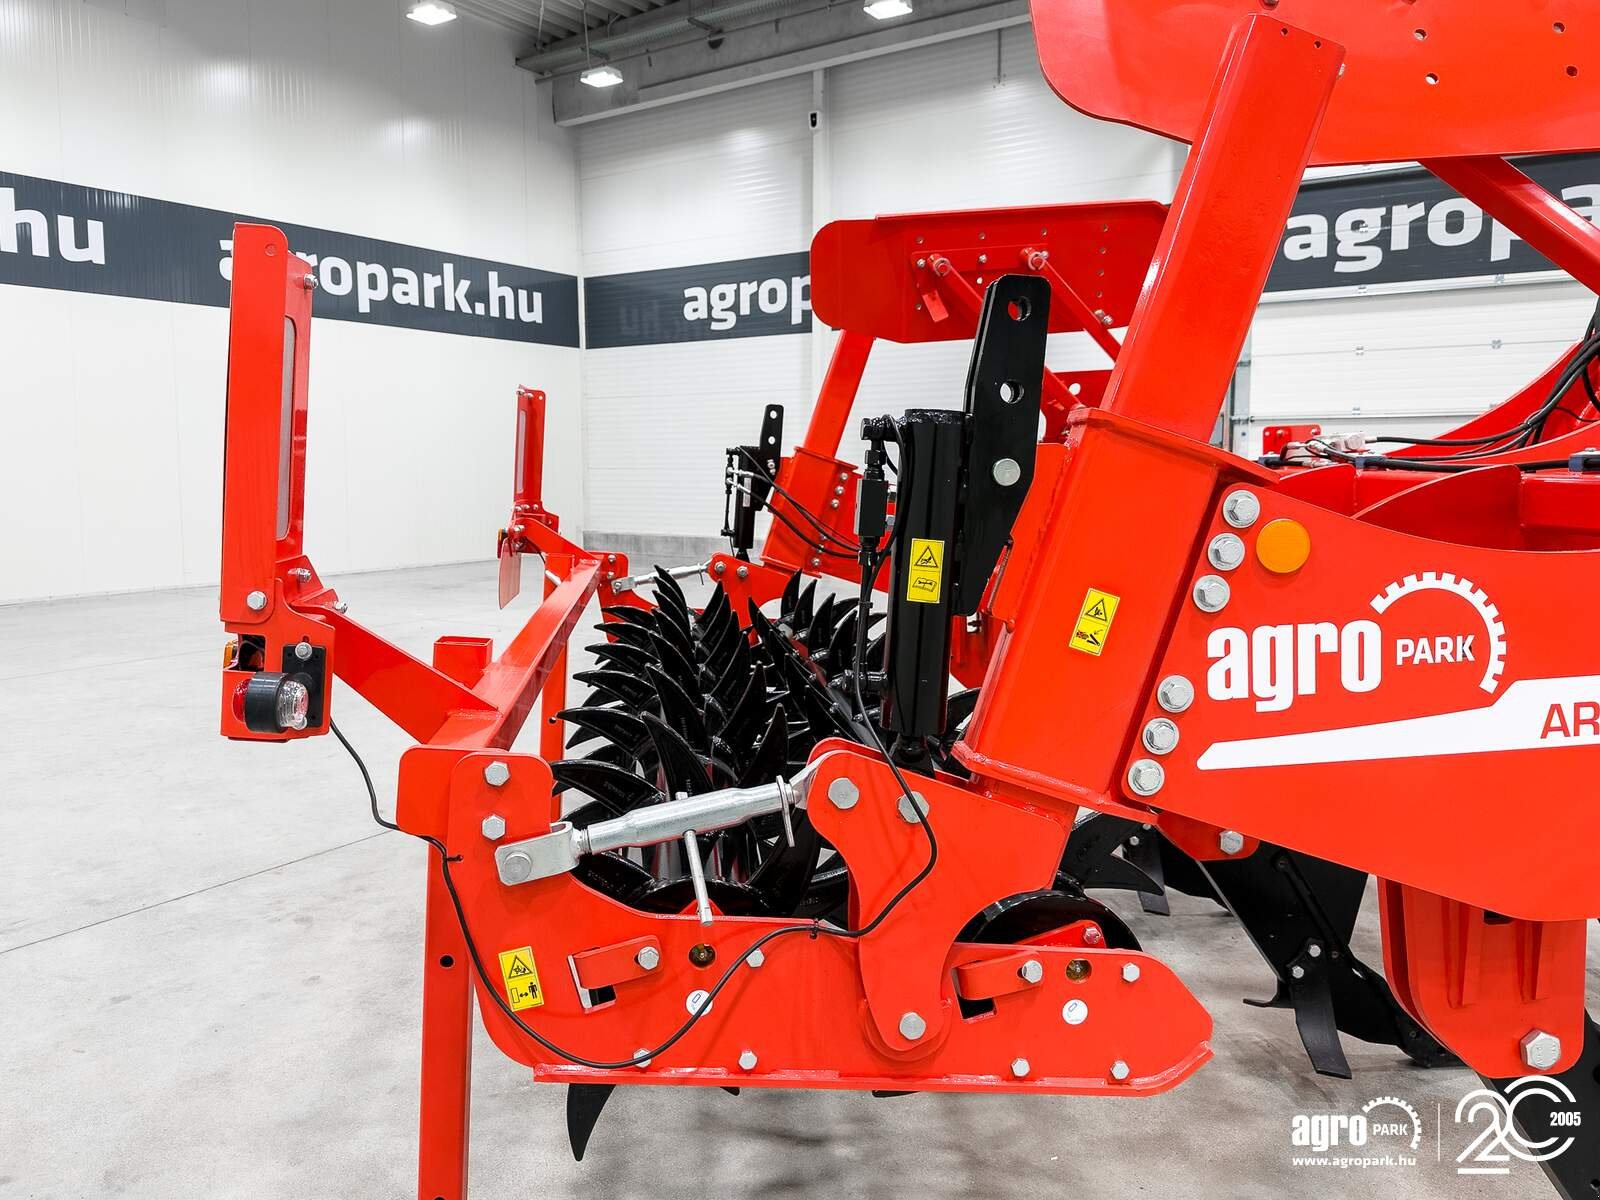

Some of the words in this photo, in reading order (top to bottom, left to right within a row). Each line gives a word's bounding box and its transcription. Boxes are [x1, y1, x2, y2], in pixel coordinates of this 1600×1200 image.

[219, 240, 543, 324] opark.hu
[1206, 619, 1382, 713] agro
[1396, 634, 1476, 666] PARK
[1540, 701, 1600, 739] AR
